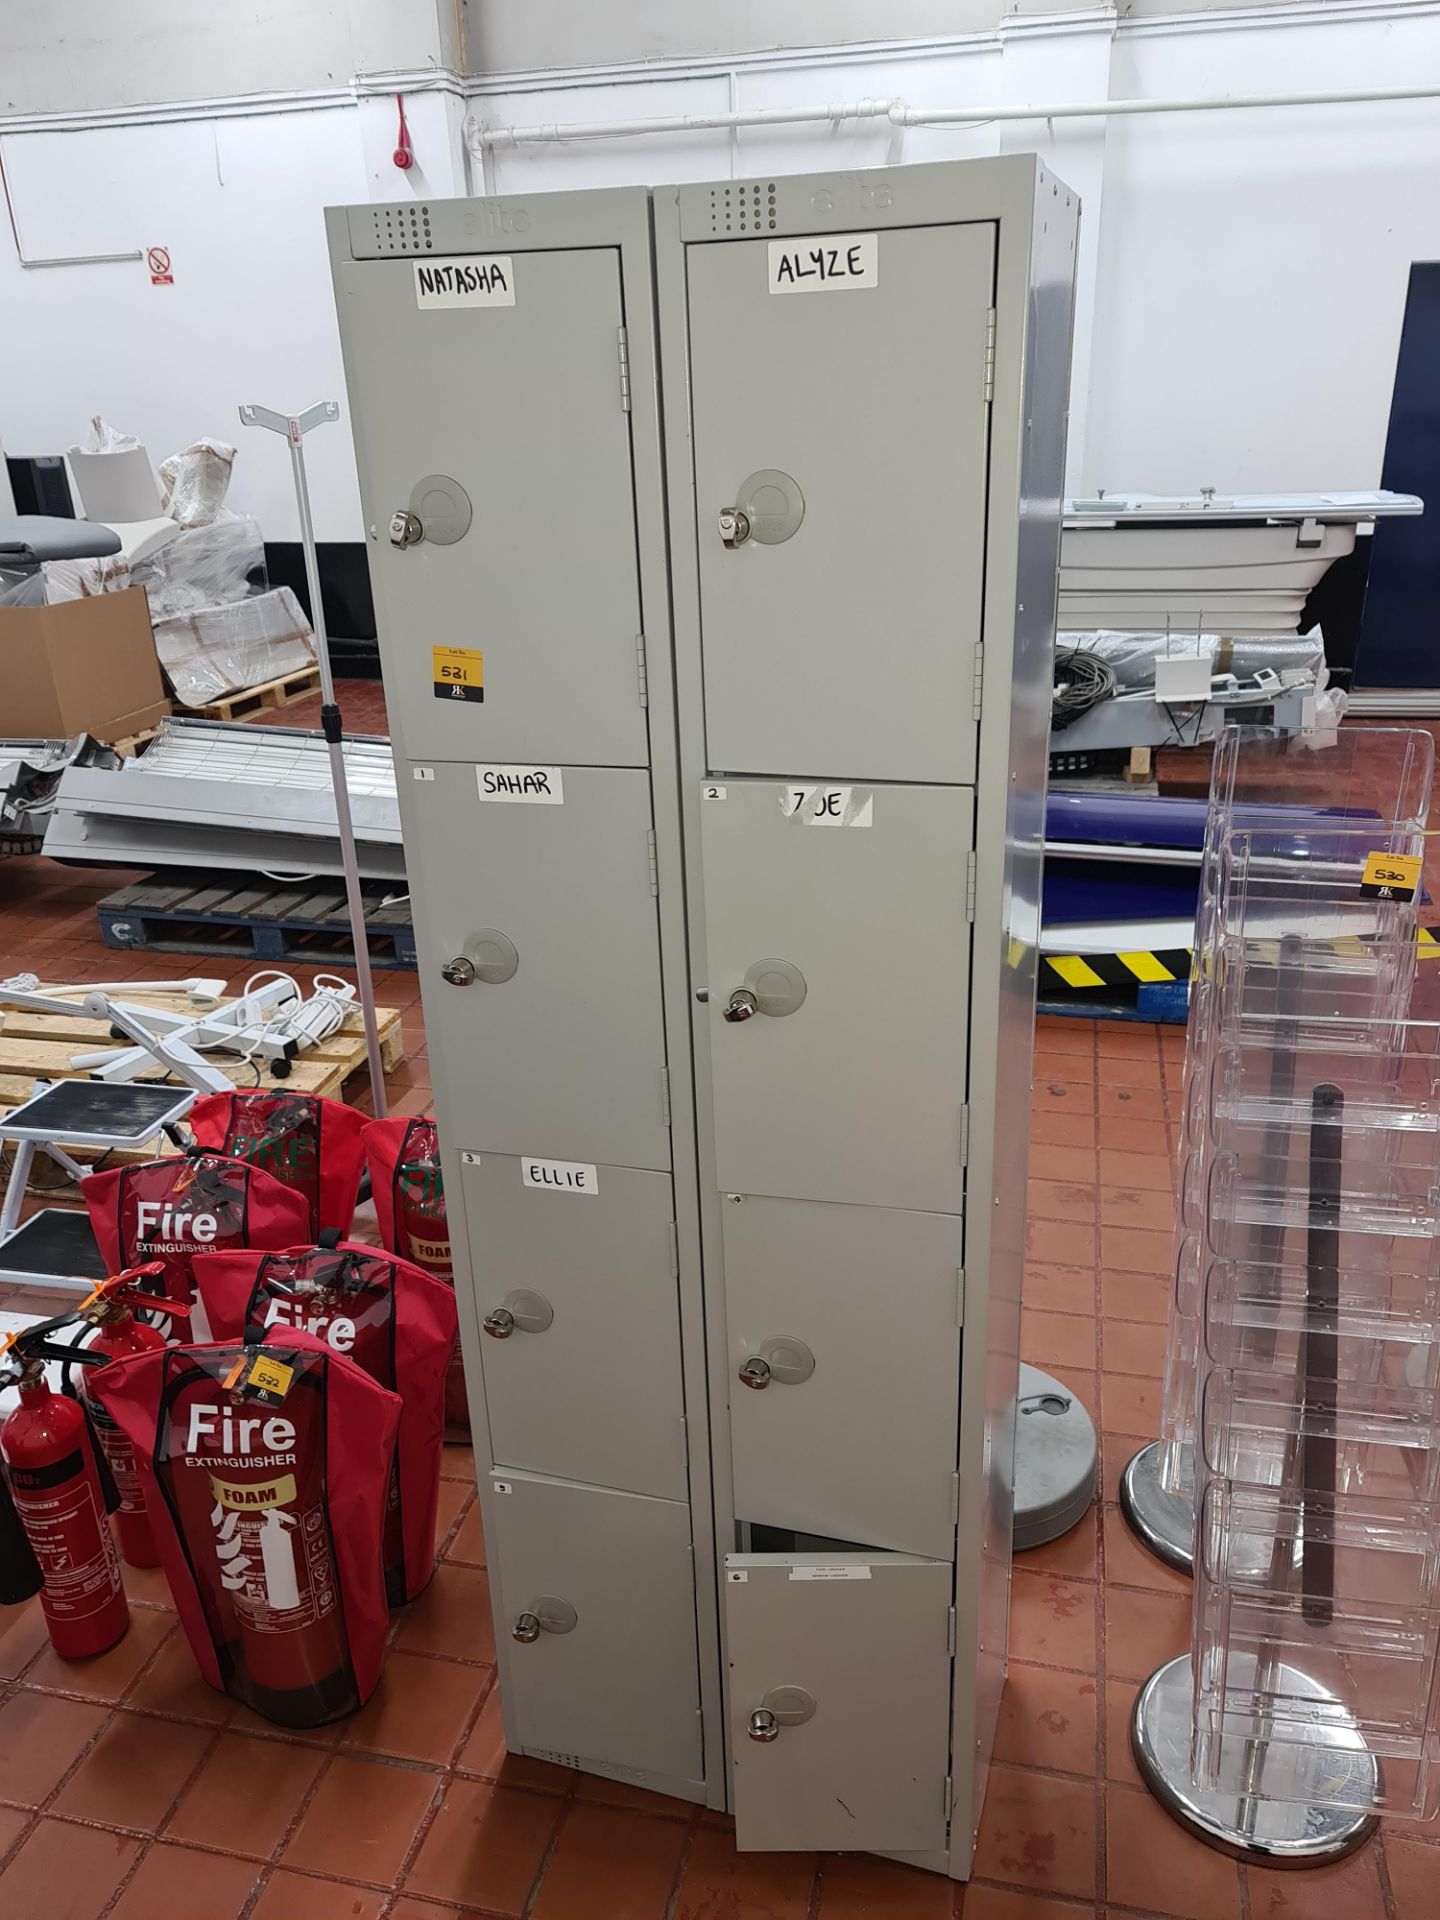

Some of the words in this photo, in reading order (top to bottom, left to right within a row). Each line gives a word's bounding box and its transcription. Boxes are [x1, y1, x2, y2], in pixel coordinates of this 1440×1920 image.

[777, 246, 864, 283] ALYZE
[418, 264, 507, 296] NATASHA
[441, 665, 467, 681] 531
[420, 769, 425, 779] 1
[483, 771, 551, 795] SAHAR
[708, 788, 719, 799] 2
[1374, 869, 1406, 882] 530
[230, 1135, 314, 1168] FIRE
[465, 1153, 474, 1163] 3
[530, 1165, 585, 1187] ELLIE
[137, 1201, 217, 1242] Fire
[136, 1242, 217, 1254] EXTINGUISHER
[264, 1297, 356, 1352] Fire
[257, 1372, 280, 1388] 532
[187, 1403, 297, 1454] Fire
[185, 1453, 297, 1469] EXTINGUISHER
[223, 1487, 277, 1505] FOAM
[732, 1573, 741, 1581] 6
